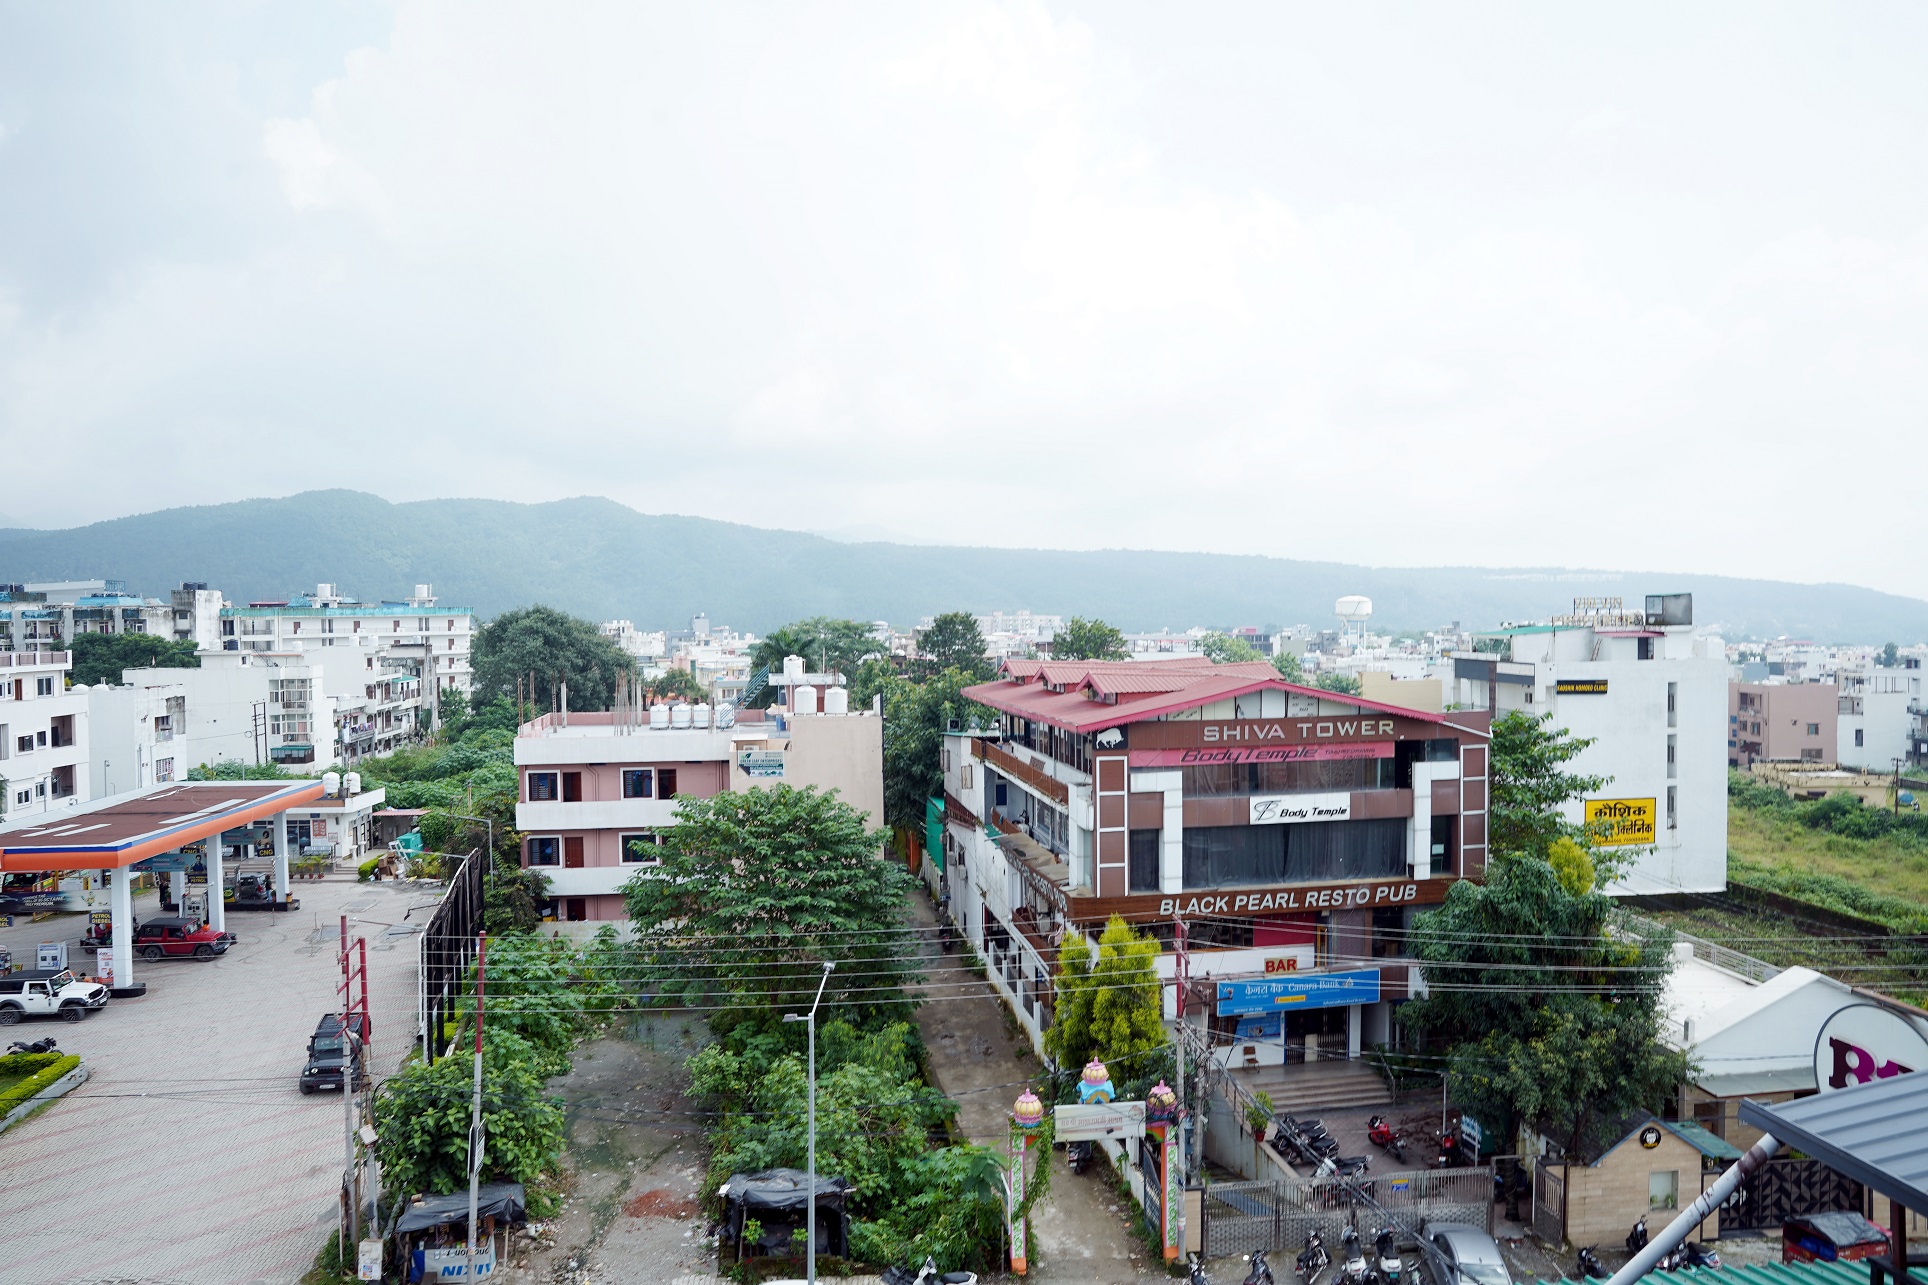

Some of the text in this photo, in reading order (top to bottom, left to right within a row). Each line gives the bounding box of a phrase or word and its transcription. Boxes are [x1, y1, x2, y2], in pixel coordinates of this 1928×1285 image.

[1203, 720, 1394, 742] SHIVA TOWER
[1181, 747, 1318, 764] Body Temple
[1280, 807, 1347, 819] Body Temple
[1594, 802, 1648, 818] कौशिक
[1159, 884, 1418, 916] BLACK PEARL RESTO PUB
[1265, 958, 1297, 973] BAR
[1288, 982, 1317, 992] Canara
[1319, 980, 1339, 990] Bank
